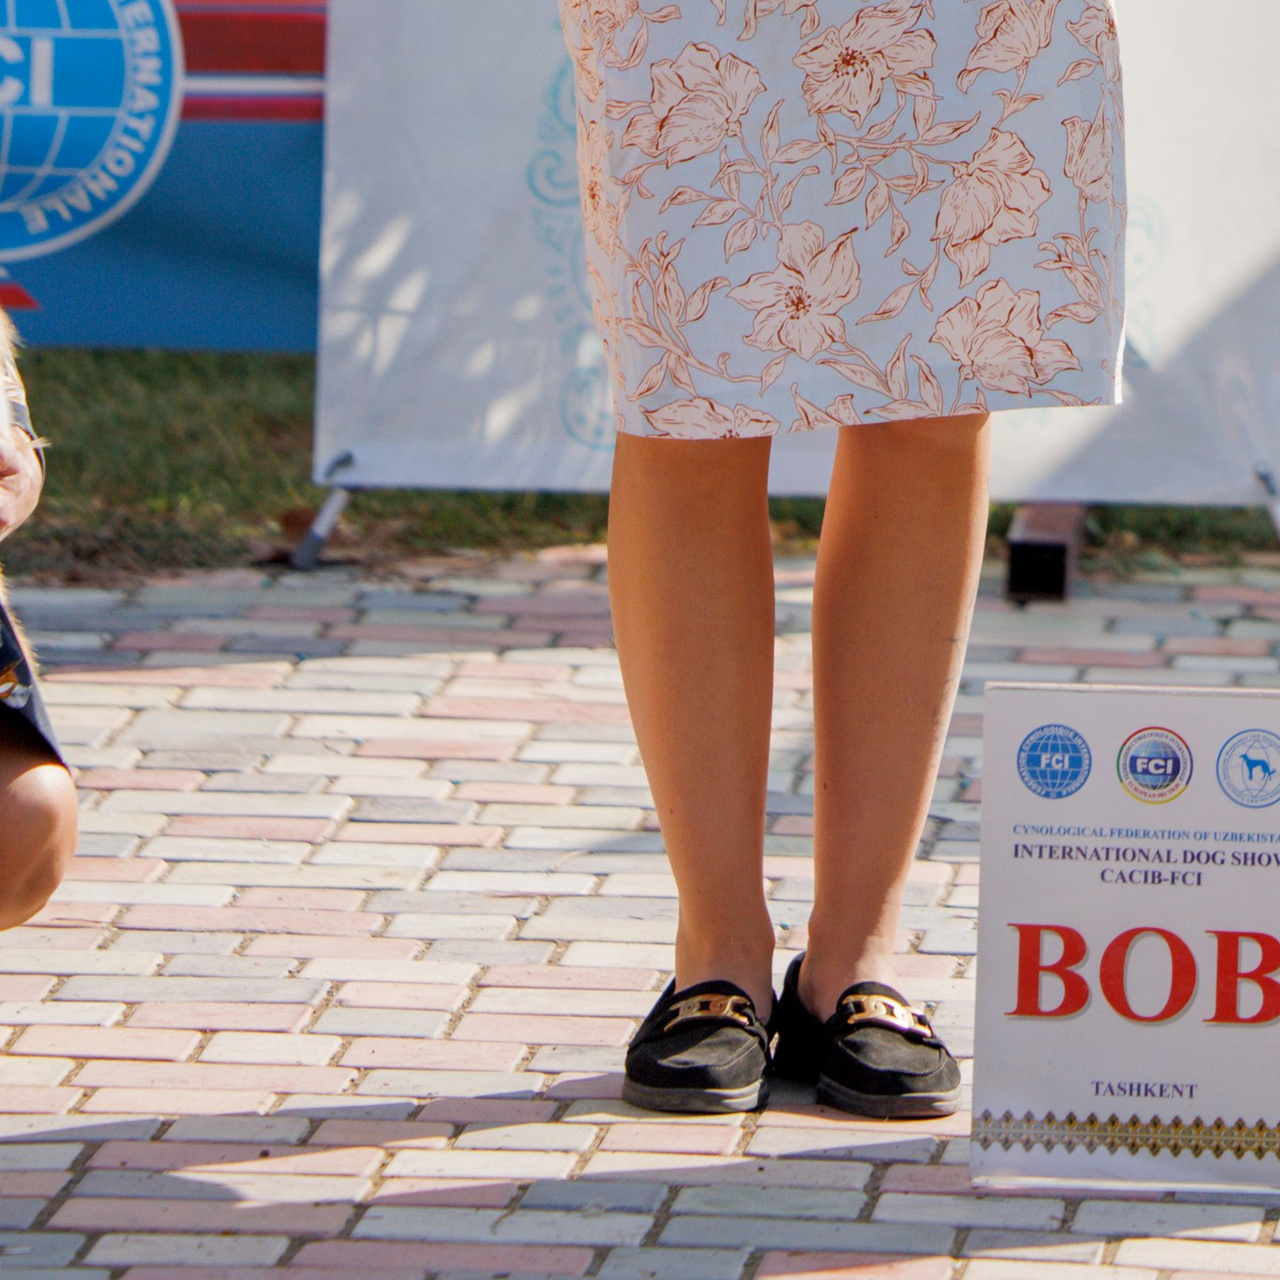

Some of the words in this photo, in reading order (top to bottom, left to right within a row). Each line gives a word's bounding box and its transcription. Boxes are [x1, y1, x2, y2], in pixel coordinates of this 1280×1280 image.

[1041, 753, 1069, 769] FCI
[1136, 758, 1173, 775] FCI
[1013, 824, 1107, 837] CYNOLOGICAL
[1110, 827, 1190, 840] FEDERATION
[1193, 830, 1210, 841] OF
[1013, 844, 1177, 863] INTERNATIONAL
[1182, 849, 1226, 865] DOG
[1100, 868, 1202, 886] CACIB-FCI
[1091, 1081, 1198, 1099] TASHKENT
